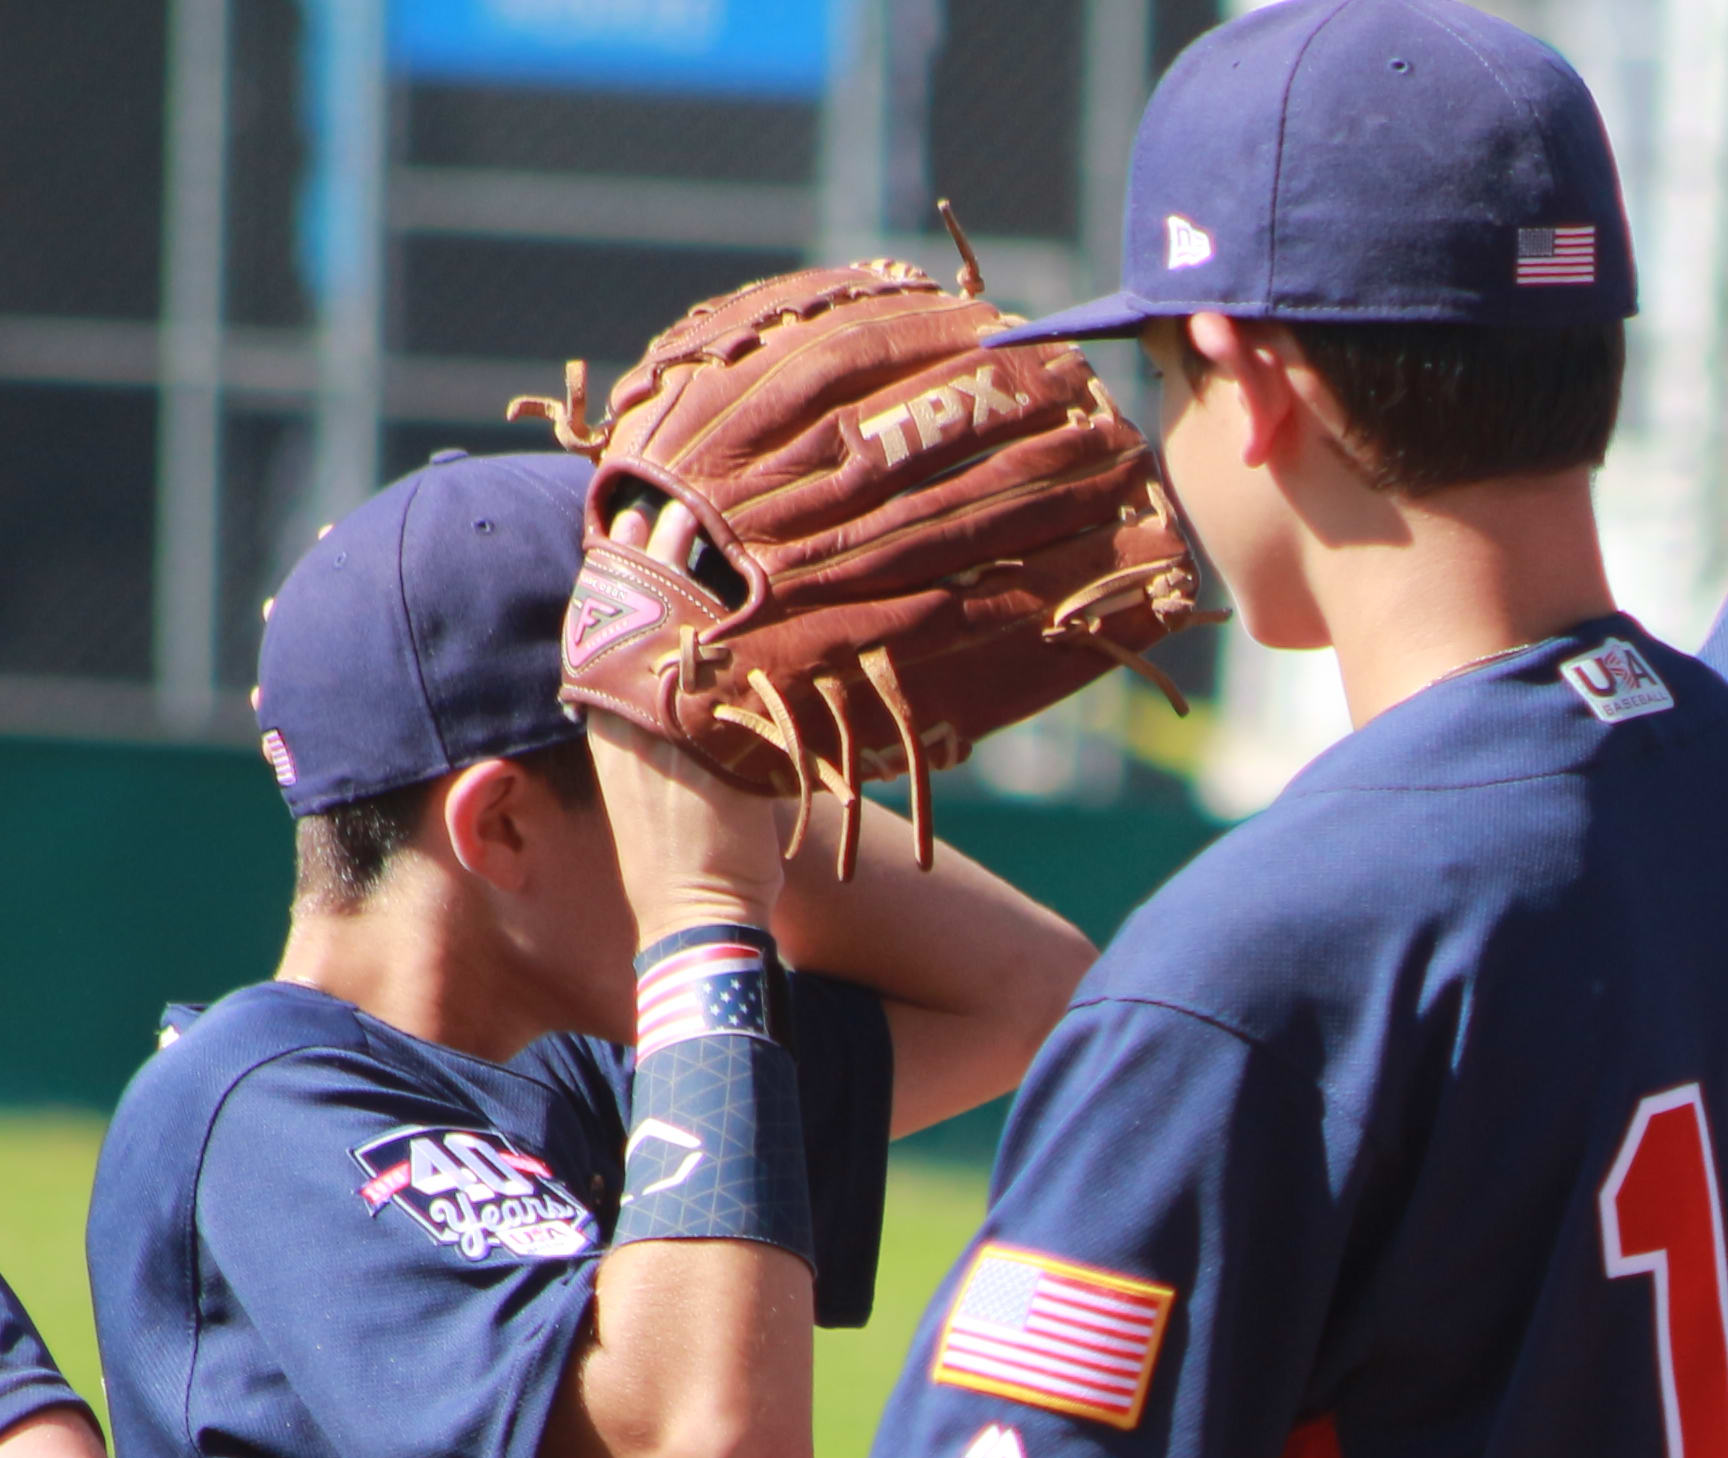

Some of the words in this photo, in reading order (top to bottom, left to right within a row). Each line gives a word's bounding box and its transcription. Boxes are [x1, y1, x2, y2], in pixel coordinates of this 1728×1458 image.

[858, 366, 1019, 467] TPX
[1571, 644, 1660, 698] USA
[409, 1133, 535, 1203] 40
[429, 1192, 577, 1262] Years
